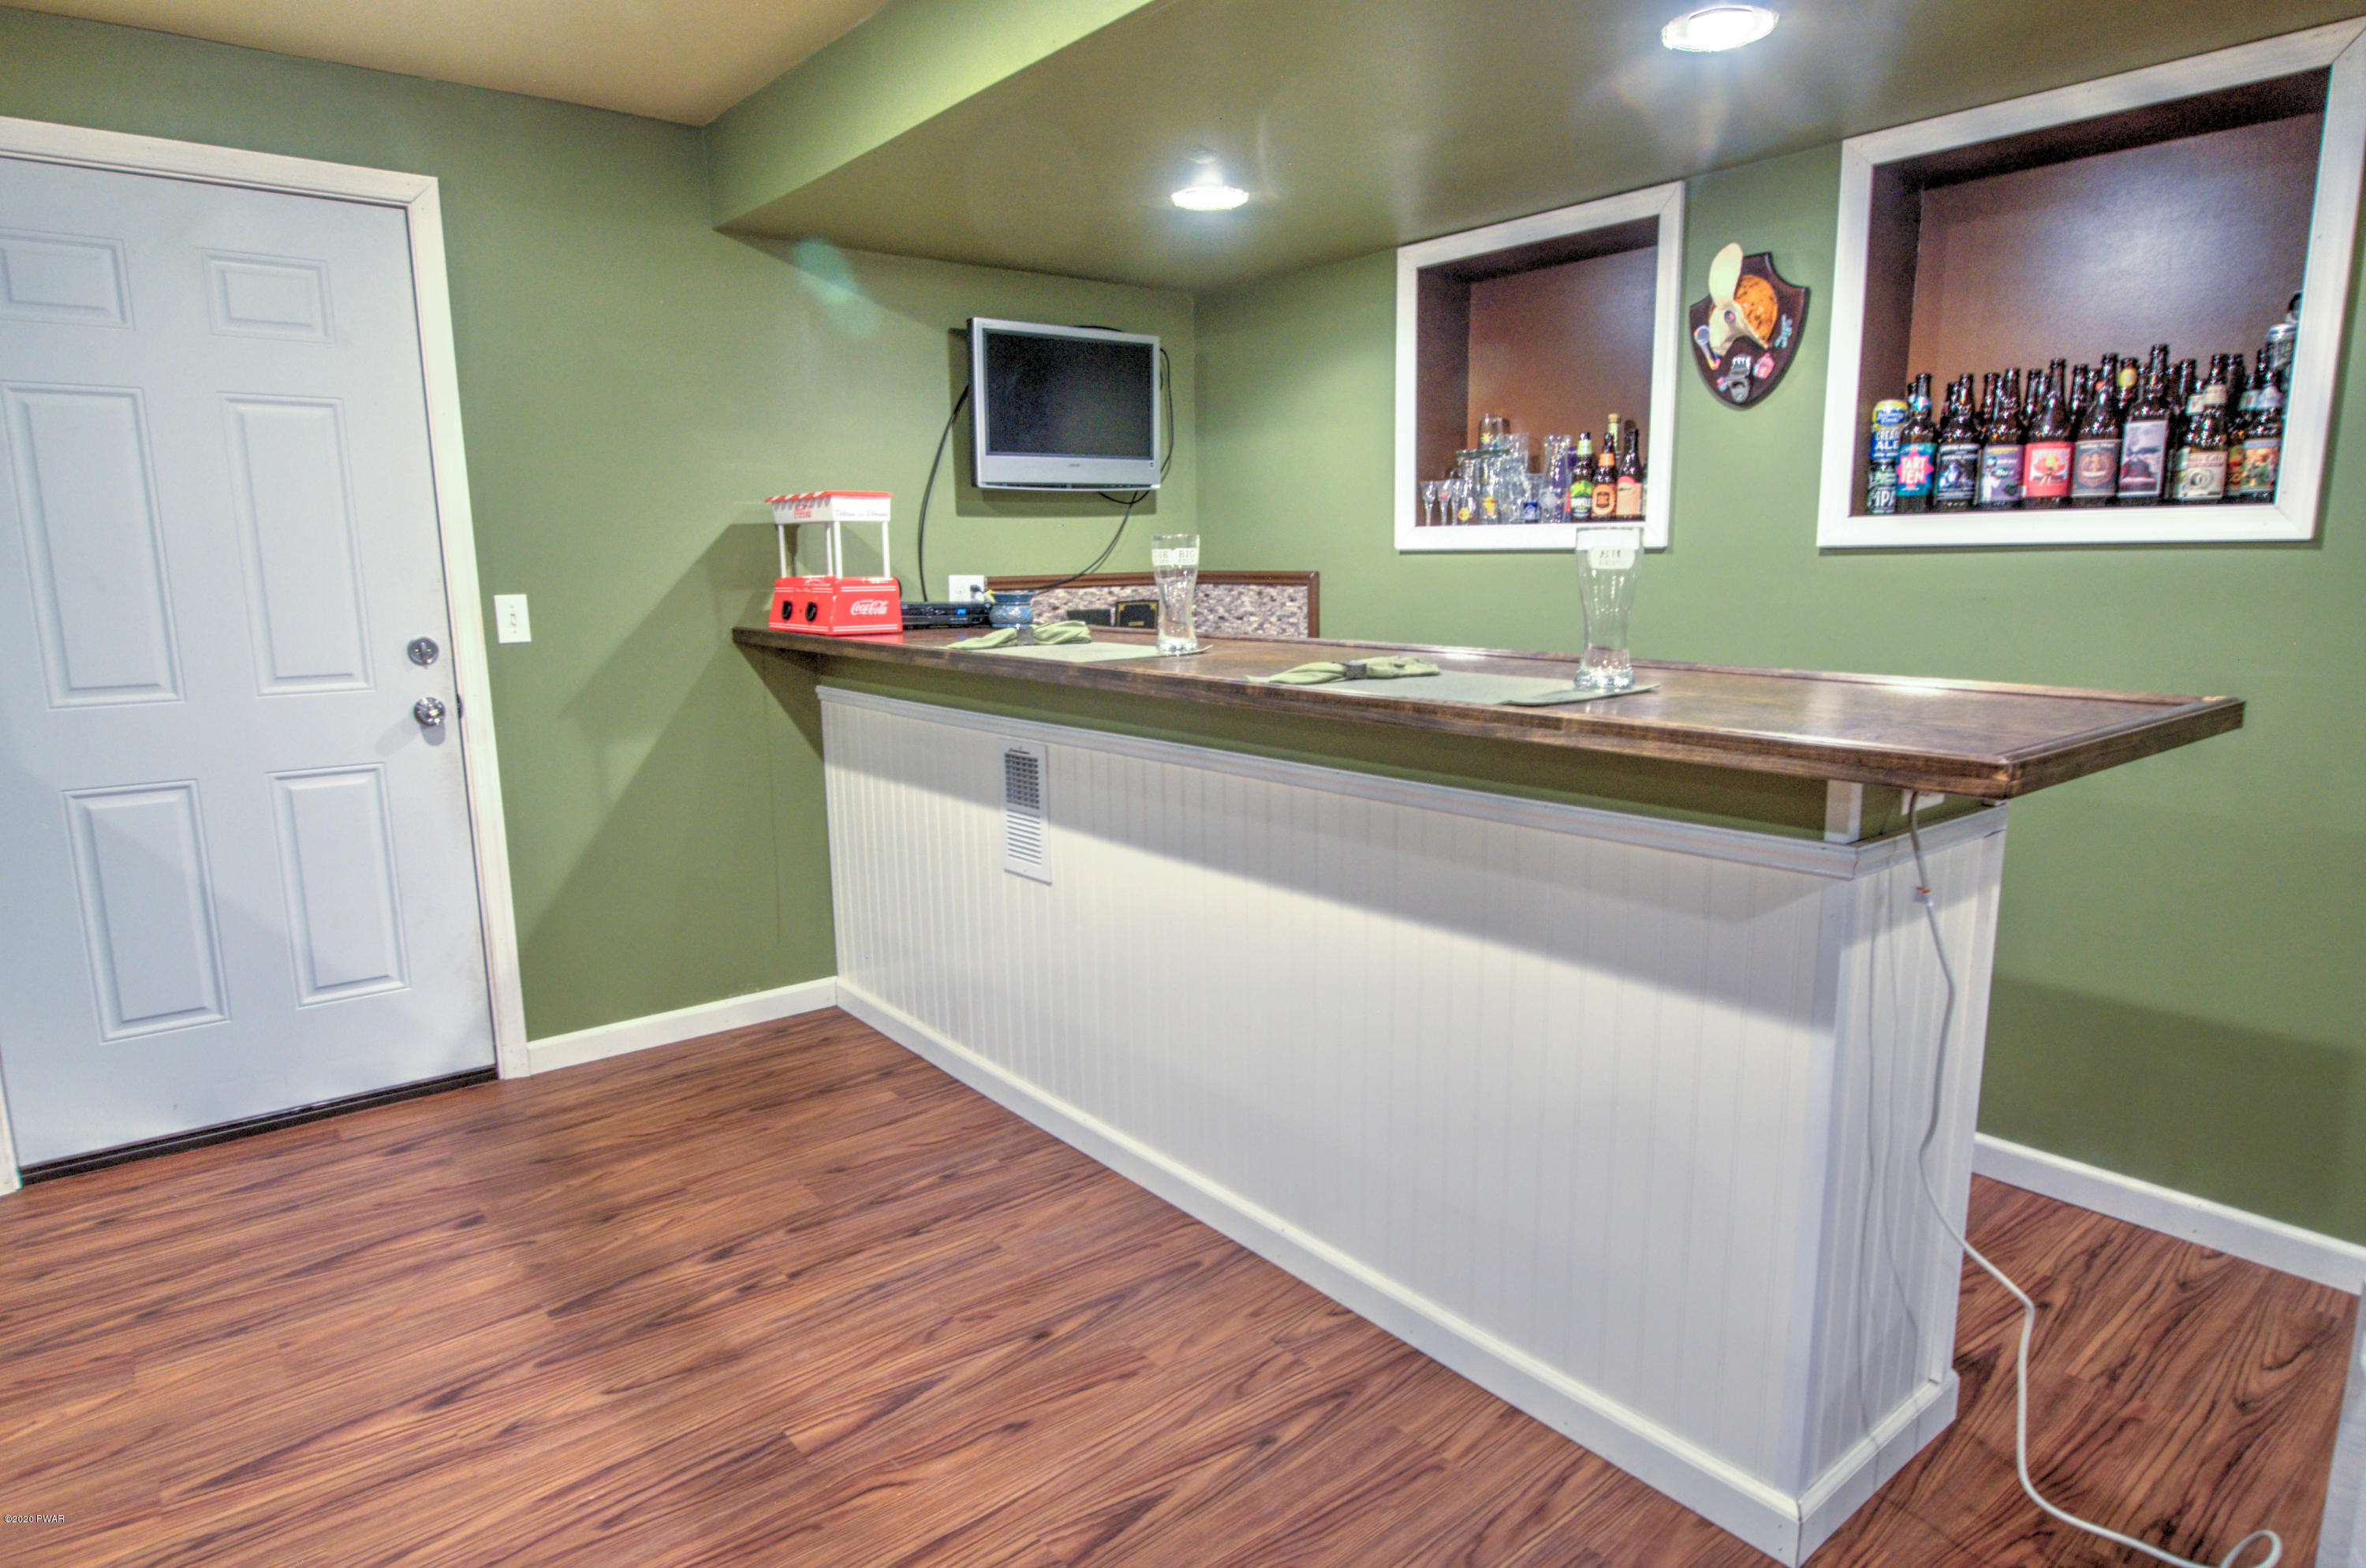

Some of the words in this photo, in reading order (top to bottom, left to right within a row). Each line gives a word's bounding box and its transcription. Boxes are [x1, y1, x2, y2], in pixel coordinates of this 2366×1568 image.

[1874, 441, 1898, 450] ALE
[1901, 456, 1926, 471] TART
[1901, 469, 1925, 483] TEN
[850, 599, 890, 615] Coca-Cola
